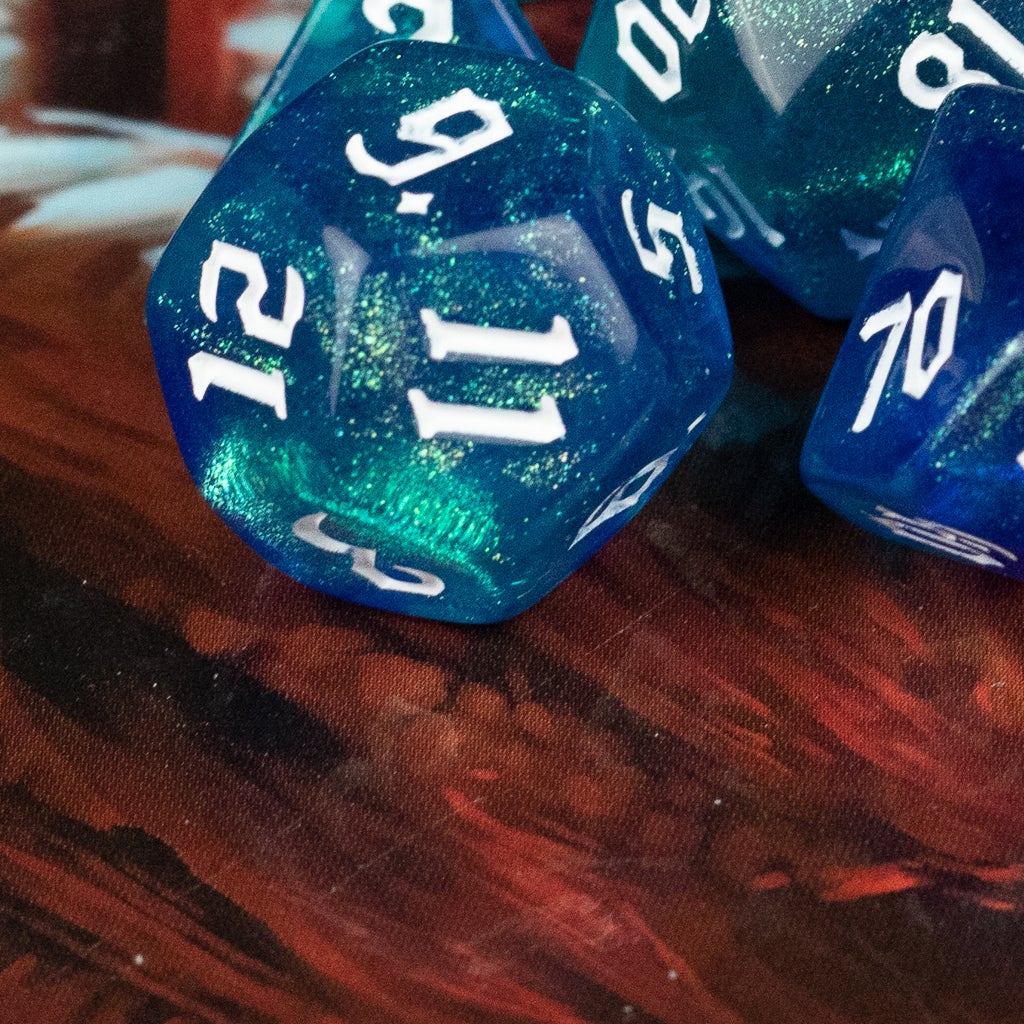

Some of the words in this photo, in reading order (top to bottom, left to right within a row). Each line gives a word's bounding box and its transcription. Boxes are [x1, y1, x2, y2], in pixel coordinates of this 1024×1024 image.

[621, 189, 703, 294] 5
[187, 239, 306, 420] 12
[406, 308, 580, 444] 11
[851, 269, 963, 433] 70
[293, 512, 446, 598] 3
